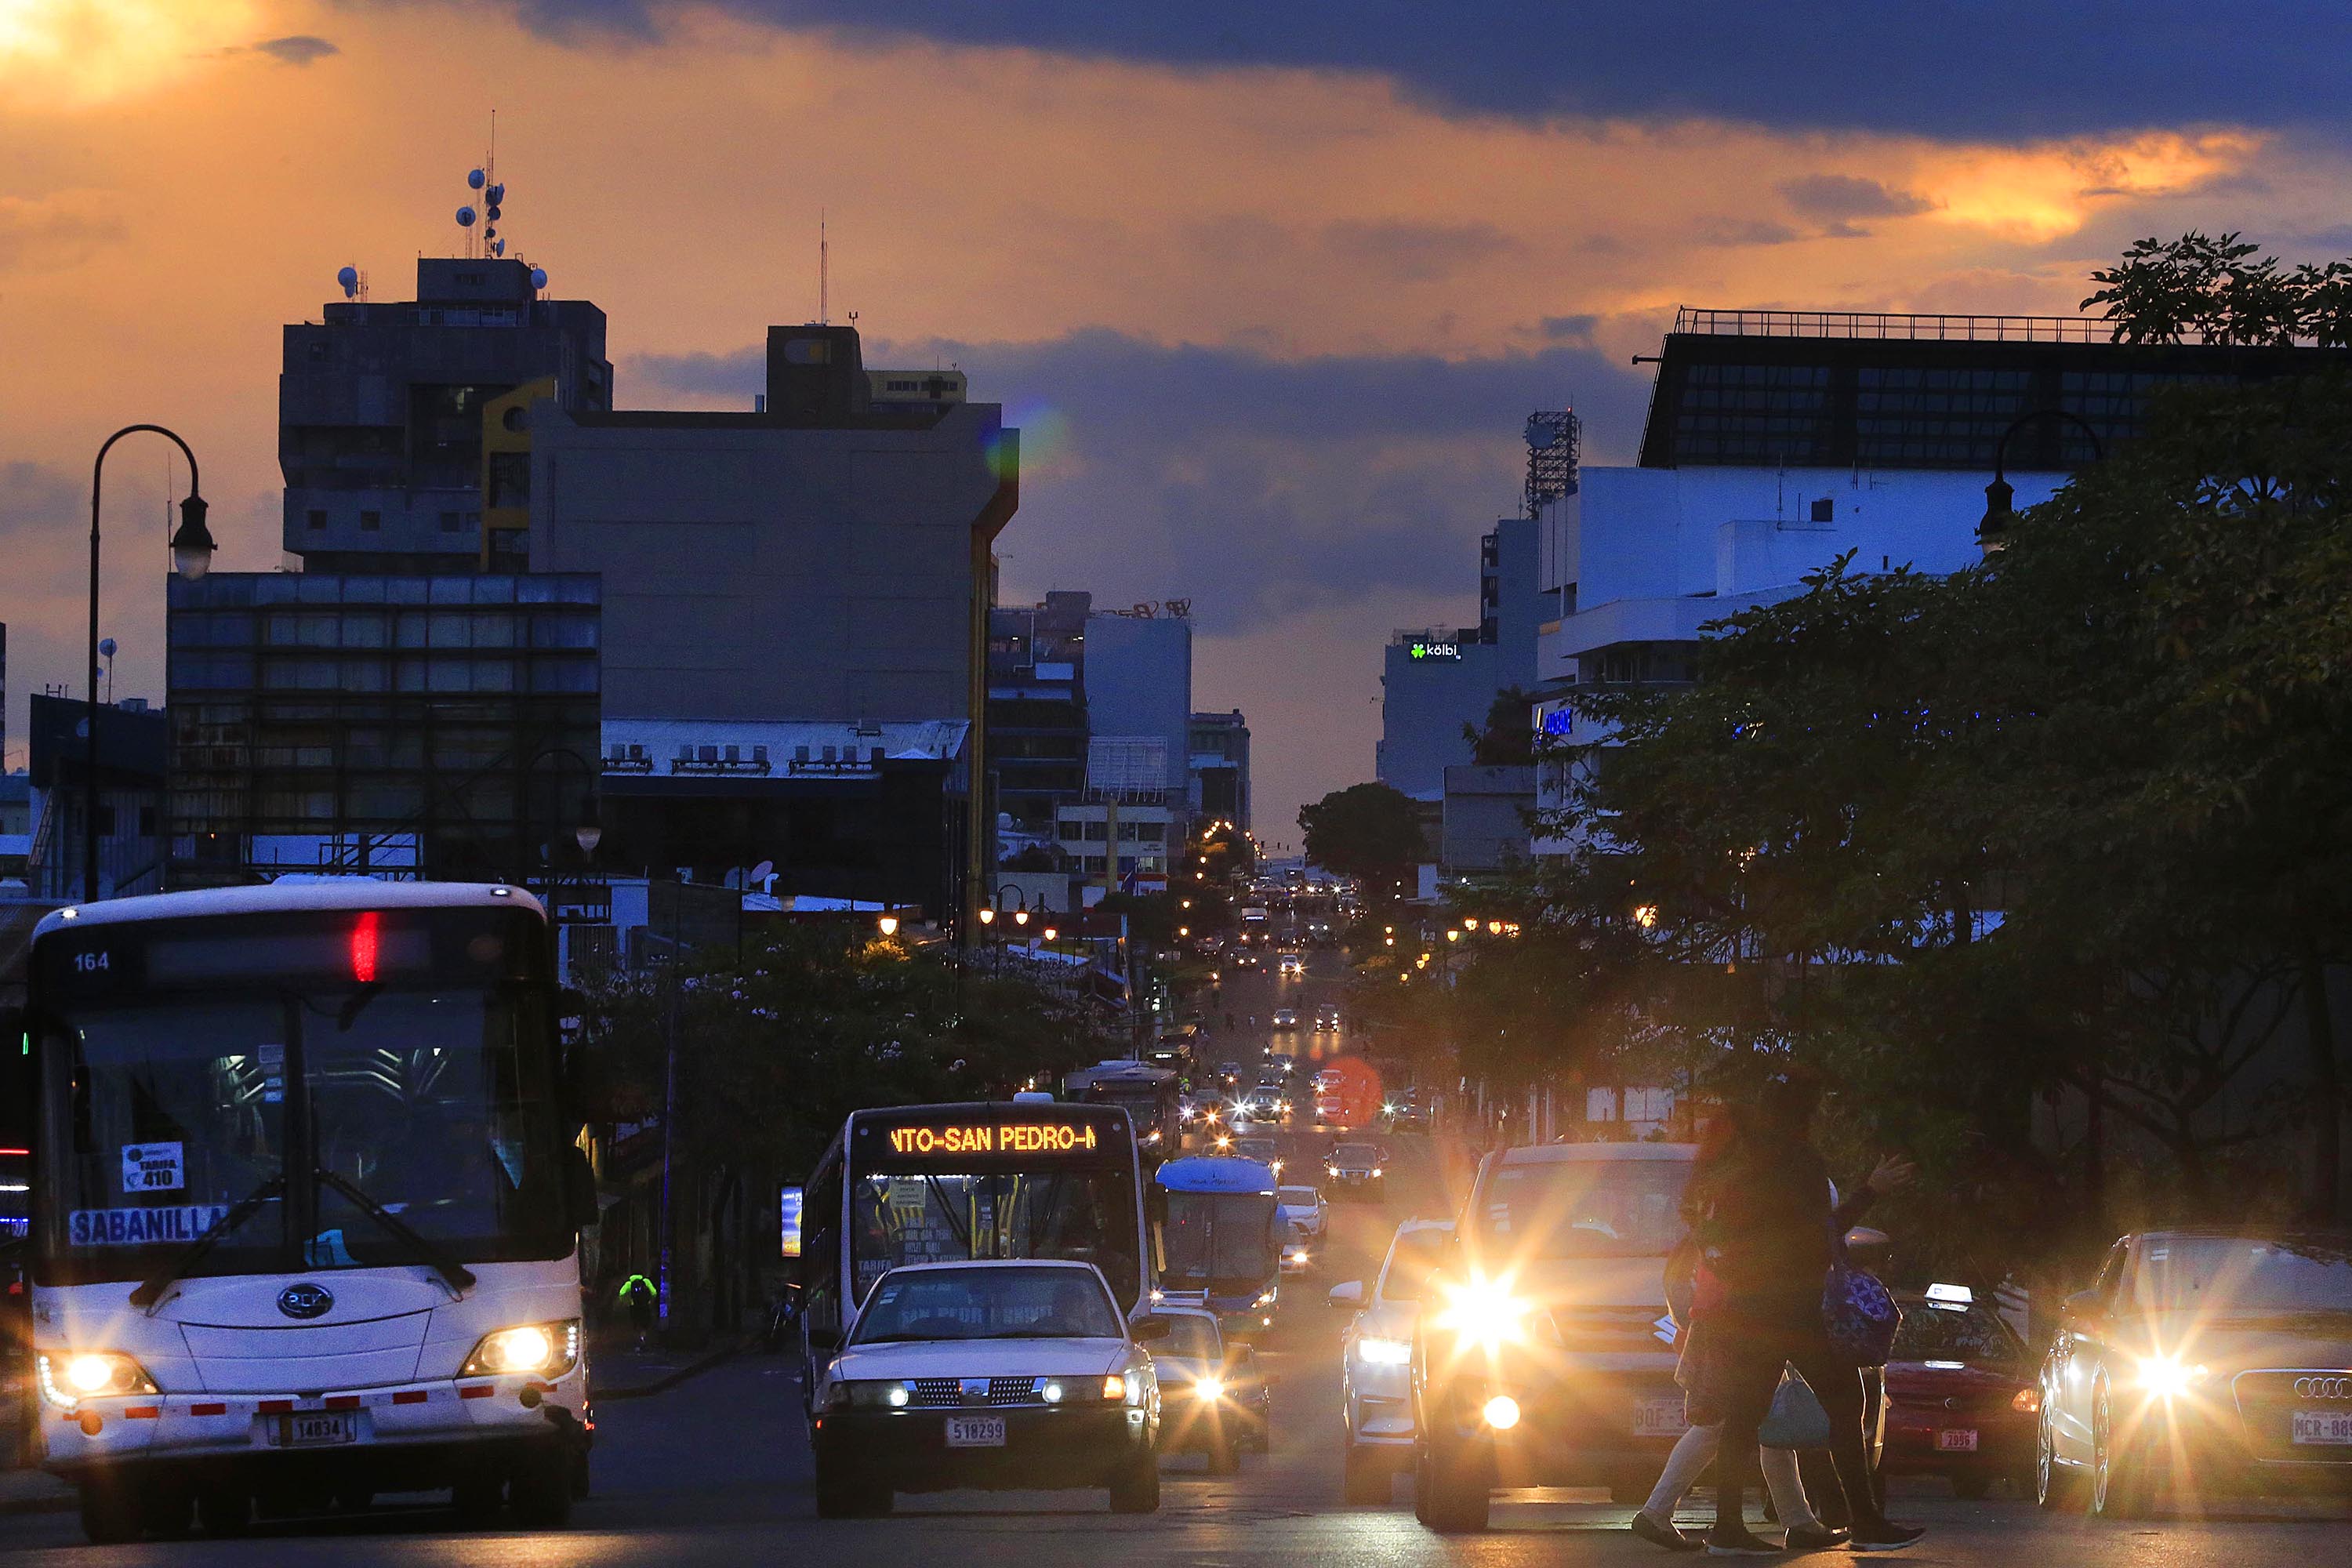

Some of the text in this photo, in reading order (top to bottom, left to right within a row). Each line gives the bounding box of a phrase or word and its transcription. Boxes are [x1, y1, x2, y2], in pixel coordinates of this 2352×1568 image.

[1426, 643, 1457, 656] kölbi
[74, 950, 110, 972] 164
[140, 1160, 176, 1171] TARIFA
[143, 1170, 173, 1186] 410
[858, 1259, 891, 1272] TARIFA
[953, 1423, 1003, 1439] 518299
